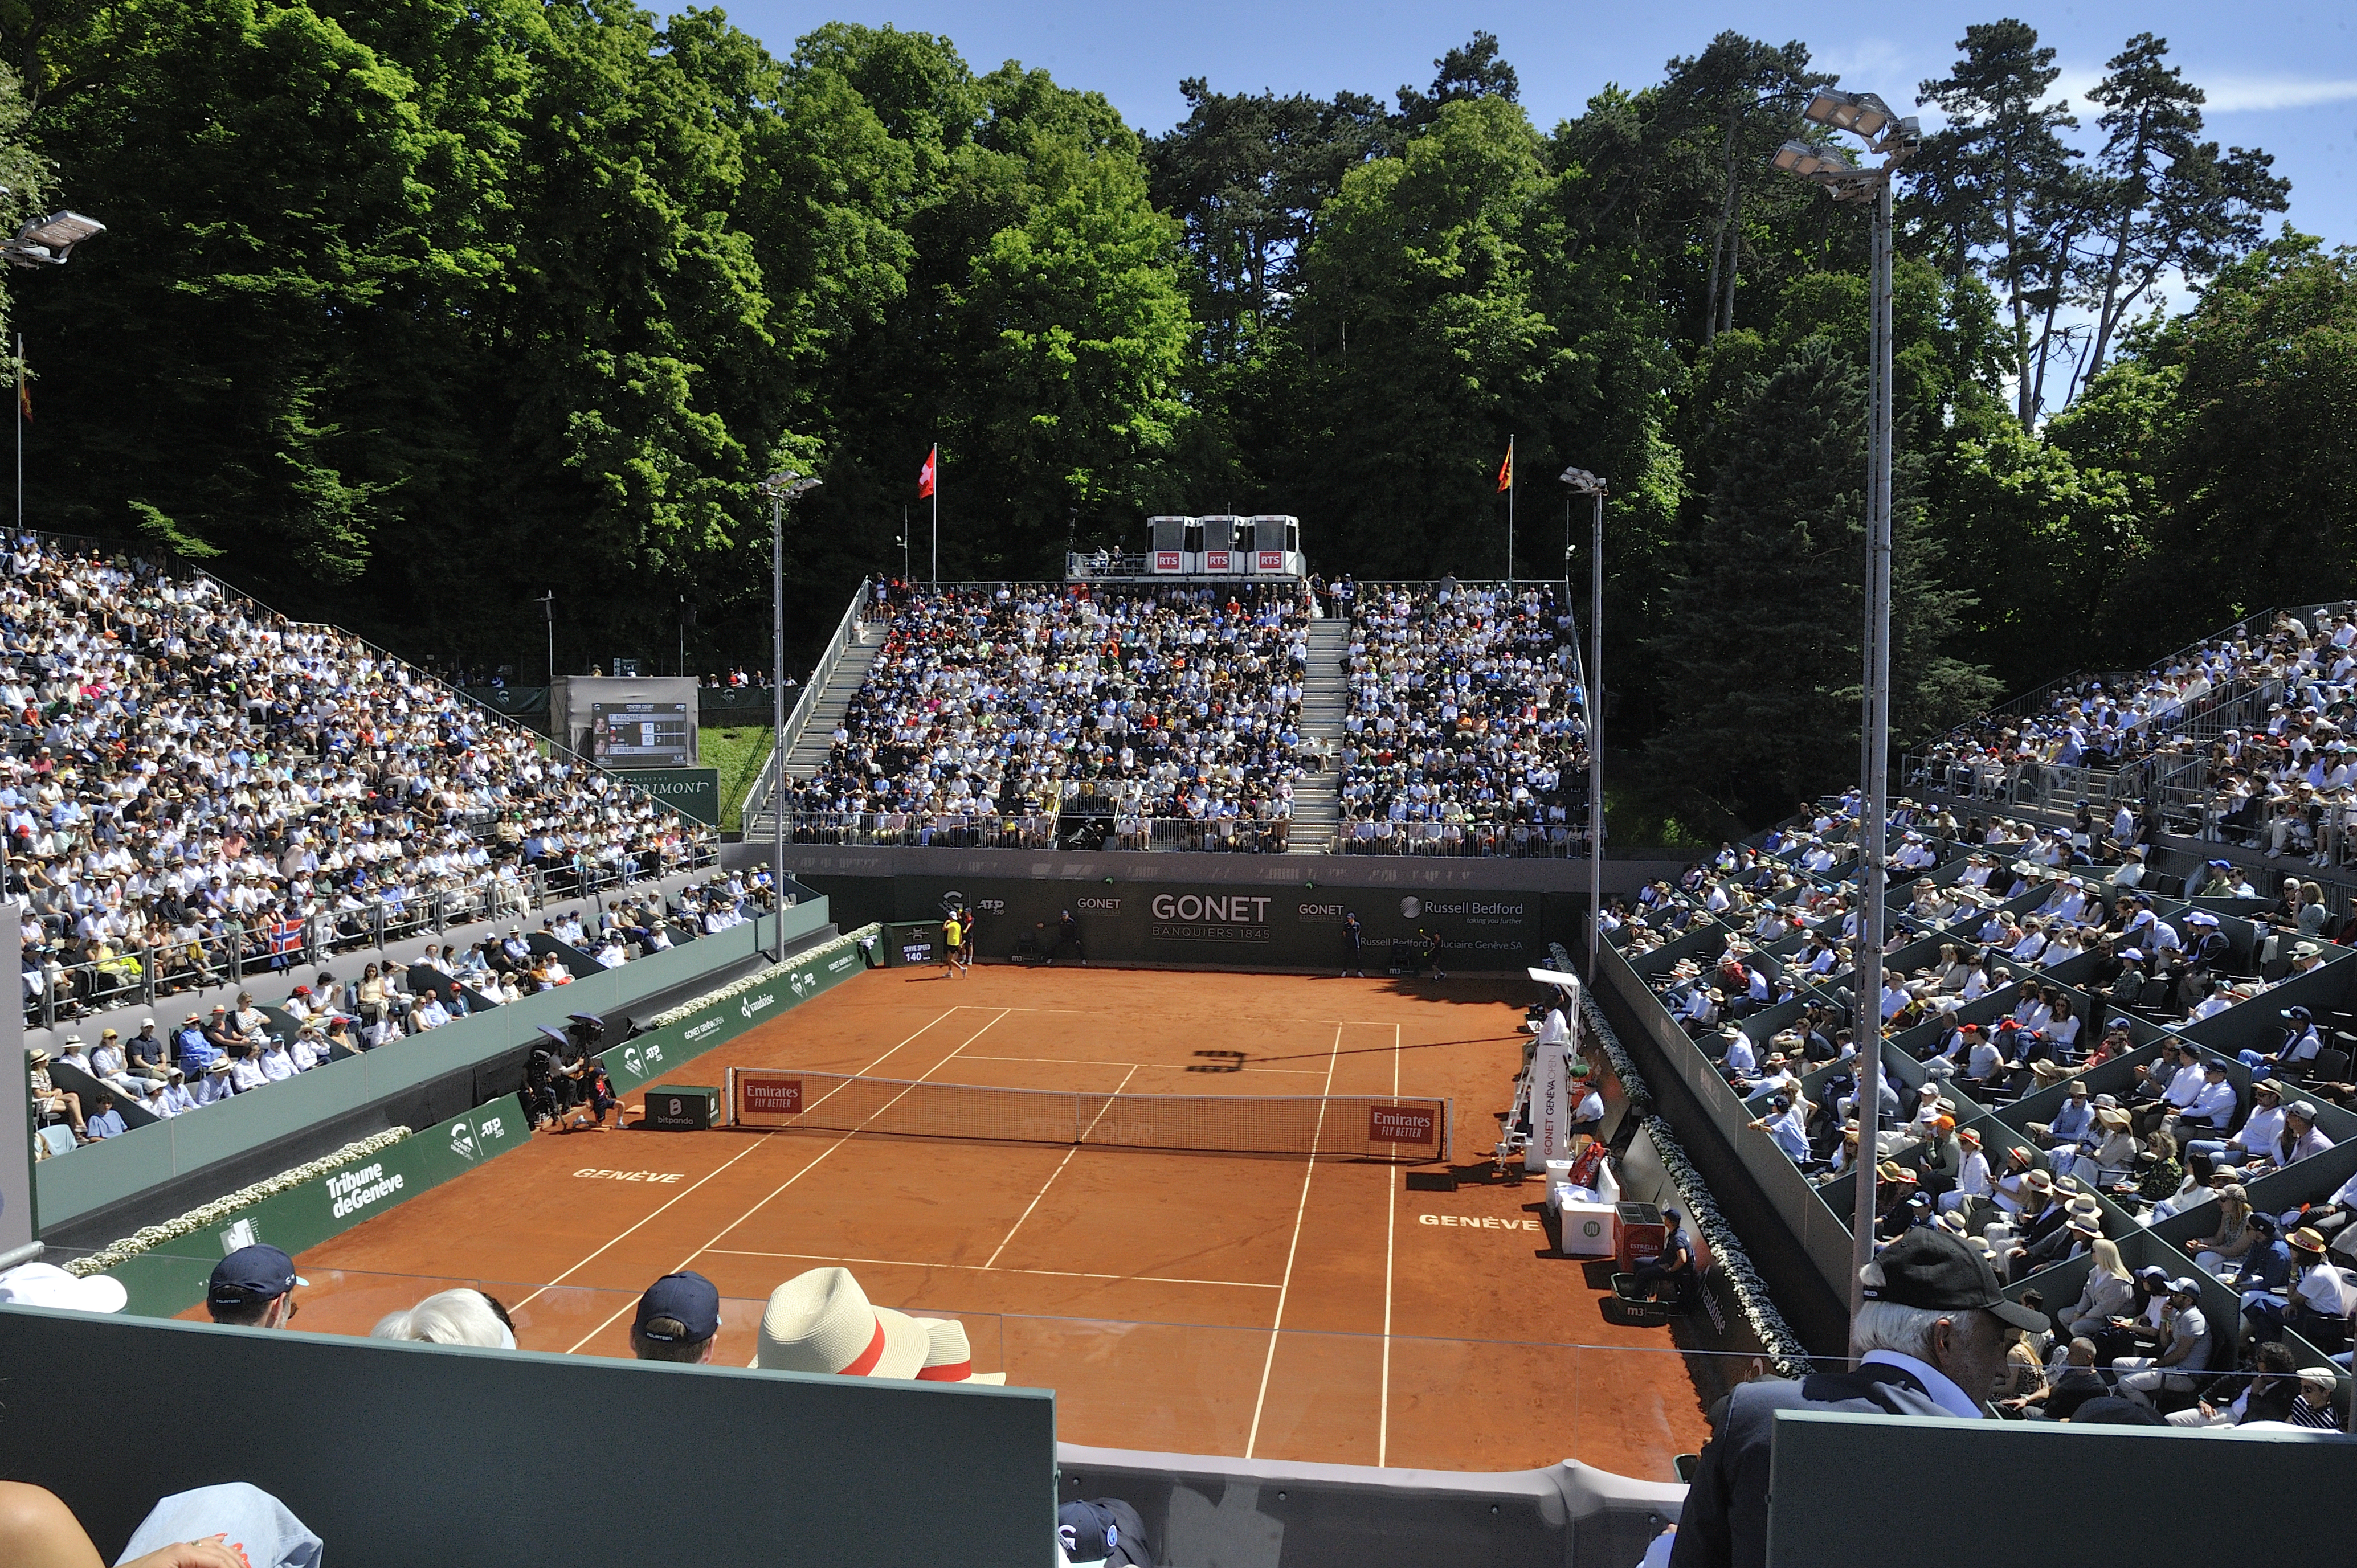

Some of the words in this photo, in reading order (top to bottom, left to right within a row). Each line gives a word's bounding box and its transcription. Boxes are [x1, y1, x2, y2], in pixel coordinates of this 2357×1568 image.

[1159, 556, 1178, 565] RTS
[1210, 556, 1228, 564] RTS
[1261, 556, 1280, 564] RTS
[977, 899, 1004, 910] ATP
[1077, 898, 1121, 909] GONET
[1152, 894, 1271, 922] GONET
[1299, 904, 1344, 915] GONET
[1425, 901, 1468, 914] Russell
[1472, 902, 1523, 914] Bedford
[1153, 926, 1233, 937] BANQUIERS
[1240, 929, 1270, 939] 1845
[1361, 937, 1390, 946] Russell
[1475, 940, 1509, 949] Genève
[906, 952, 922, 961] 140
[750, 994, 774, 1012] vaudoise
[684, 1026, 700, 1039] GONET
[646, 1045, 660, 1061] ATP
[747, 1085, 798, 1098] Emirates
[755, 1098, 766, 1107] FLY
[767, 1098, 791, 1108] BETTER
[657, 1116, 693, 1125] bitpanda
[1374, 1112, 1431, 1127] Emirates
[480, 1117, 501, 1137] ATP
[494, 1128, 504, 1139] 250
[1382, 1126, 1394, 1136] FLY
[1395, 1127, 1421, 1138] BETTER
[1544, 1118, 1553, 1156] GONET
[454, 1139, 472, 1153] GONET
[326, 1162, 382, 1199] Tribune
[573, 1168, 685, 1183] GENÈVE
[333, 1174, 403, 1218] deGenève
[1419, 1214, 1540, 1231] GENÈVE
[1627, 1307, 1644, 1316] m3
[1701, 1283, 1726, 1336] vaudoise
[646, 1332, 673, 1341] FOURTEEN
